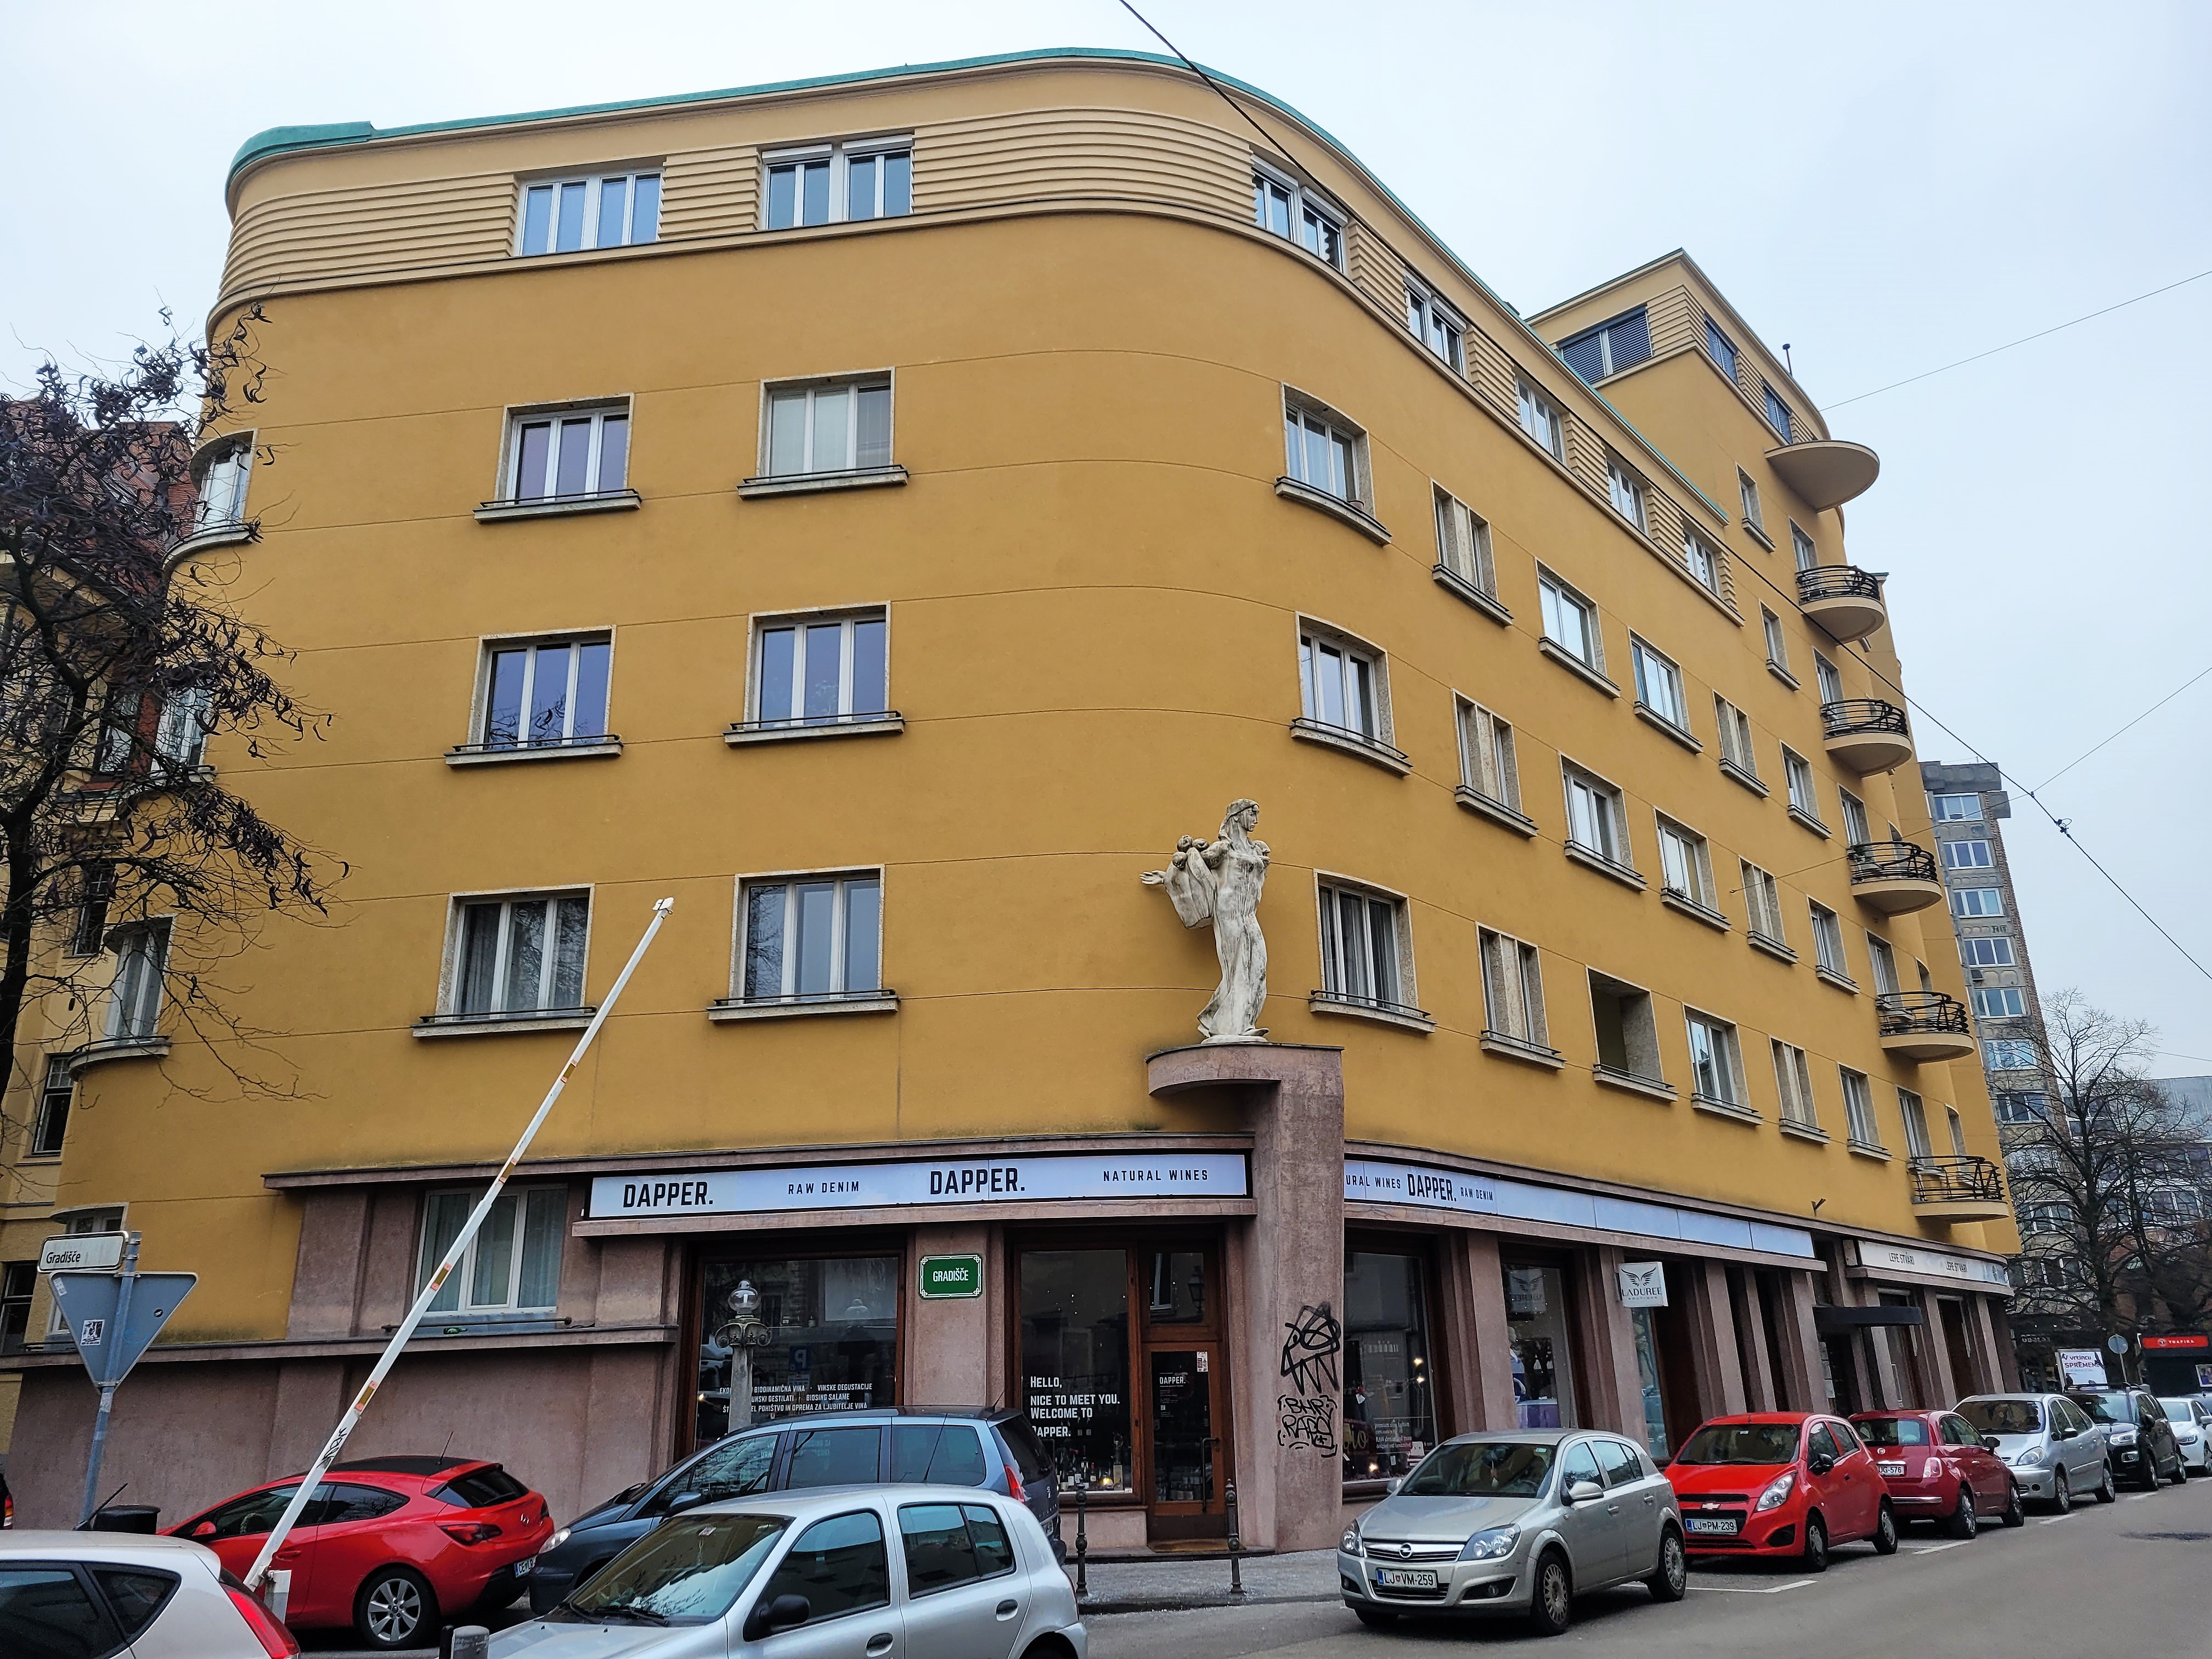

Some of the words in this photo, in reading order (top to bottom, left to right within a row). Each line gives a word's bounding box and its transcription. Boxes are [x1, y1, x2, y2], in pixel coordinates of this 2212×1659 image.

[930, 1167, 1025, 1195] DAPPER.
[1103, 1170, 1161, 1181] NATURAL
[1169, 1170, 1207, 1181] WINES
[788, 1183, 814, 1194] RAW
[821, 1181, 859, 1193] DENIM
[1375, 1177, 1401, 1189] WINES
[1407, 1173, 1457, 1202] DAPPER.
[623, 1181, 713, 1208] DAPPER.
[1460, 1187, 1473, 1198] RAW
[1476, 1189, 1493, 1201] DENIM
[46, 1250, 81, 1264] Gradišče
[933, 1267, 969, 1282] GRADIŠČE
[1159, 1376, 1186, 1384] DAPPER.
[754, 1384, 792, 1393] BIODINAMIČNA
[793, 1384, 805, 1392] VINA
[817, 1384, 837, 1392] VINSKE
[837, 1383, 873, 1391] DEGUSTACIJE
[768, 1394, 794, 1402] DESTILATI
[1030, 1395, 1052, 1406] NICE
[1054, 1395, 1066, 1405] TO
[1069, 1394, 1096, 1405] MEET
[1098, 1393, 1120, 1404] YOU.
[758, 1403, 785, 1412] POHIŠTVO
[823, 1402, 853, 1410] LJUBITELJE
[1030, 1407, 1078, 1419] WELCOME
[1081, 1407, 1093, 1418] TO
[1692, 1521, 1702, 1530] LJ
[1707, 1521, 1734, 1531] PM-239
[1384, 1572, 1395, 1584] LJ
[1401, 1573, 1434, 1586] VM-259
